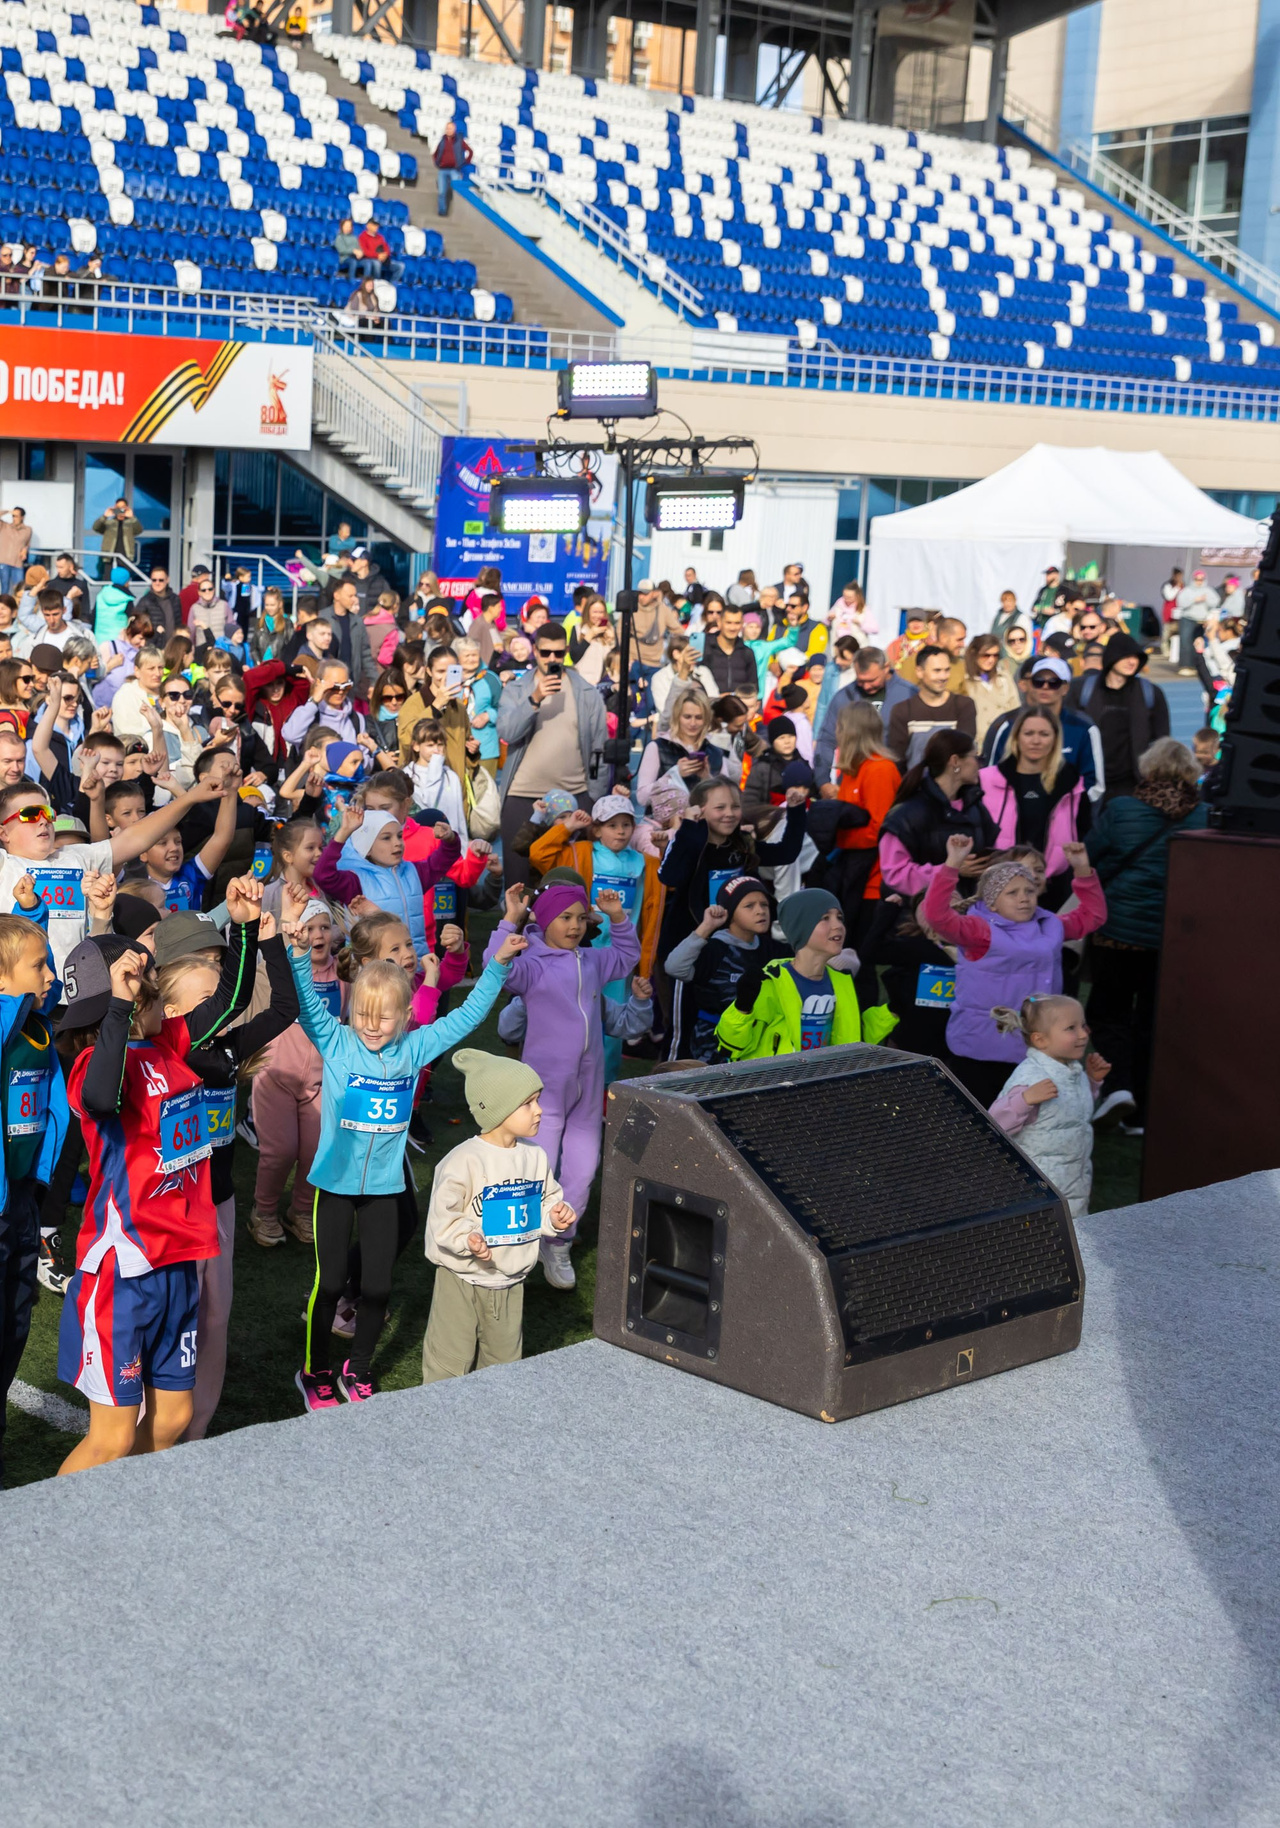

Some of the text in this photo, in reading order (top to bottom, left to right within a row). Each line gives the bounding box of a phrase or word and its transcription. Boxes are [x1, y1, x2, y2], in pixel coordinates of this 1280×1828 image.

[13, 366, 124, 410] ПОБЕДА!
[41, 886, 75, 905] 682
[63, 964, 78, 999] 5
[207, 1105, 236, 1133] 34
[367, 1098, 398, 1120] 35
[173, 1114, 201, 1151] 632
[507, 1204, 528, 1229] 13
